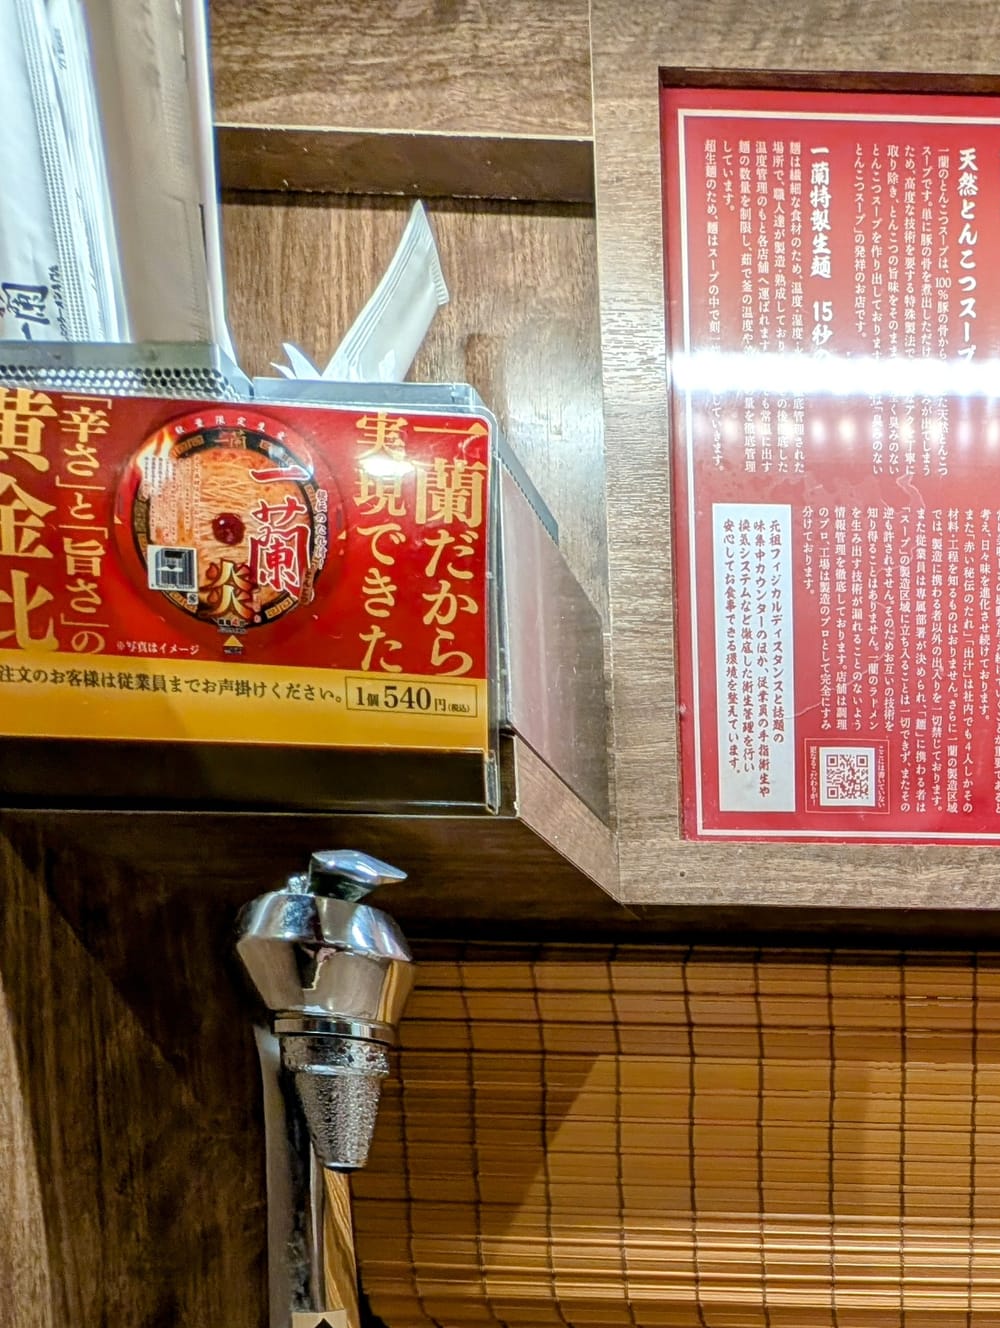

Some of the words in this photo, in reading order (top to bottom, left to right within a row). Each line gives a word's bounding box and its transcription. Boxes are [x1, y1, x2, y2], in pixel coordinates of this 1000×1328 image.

[722, 140, 735, 212] しています。
[810, 145, 832, 279] 一蘭特製生麺
[353, 411, 410, 673] 実現できた
[413, 420, 489, 678] 一蘭だから
[769, 519, 784, 743] 元祖フィジカルディスタンスと話題の
[802, 507, 815, 595] 分けております。
